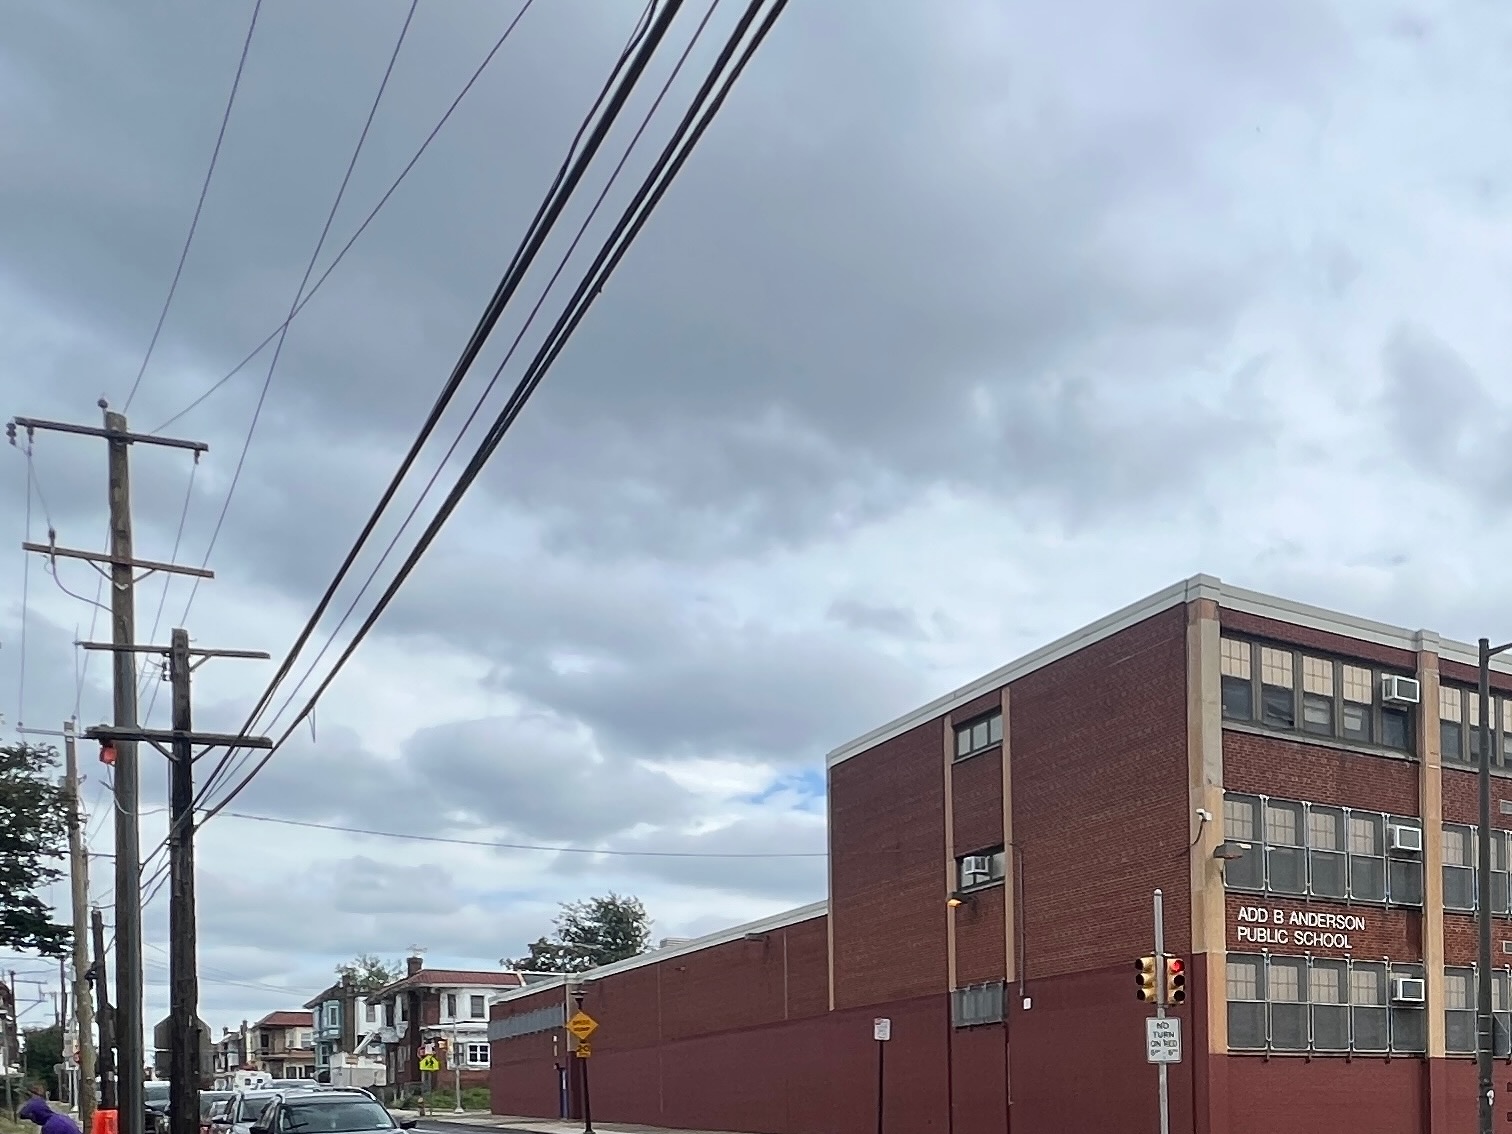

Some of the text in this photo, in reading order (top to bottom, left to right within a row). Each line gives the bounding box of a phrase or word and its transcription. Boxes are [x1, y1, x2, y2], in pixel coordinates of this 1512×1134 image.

[1237, 905, 1365, 931] ADD B ANDERSON
[1237, 926, 1353, 949] PUBLIC SCHOOL
[1156, 1021, 1170, 1030] NO
[1153, 1031, 1175, 1039] TURN
